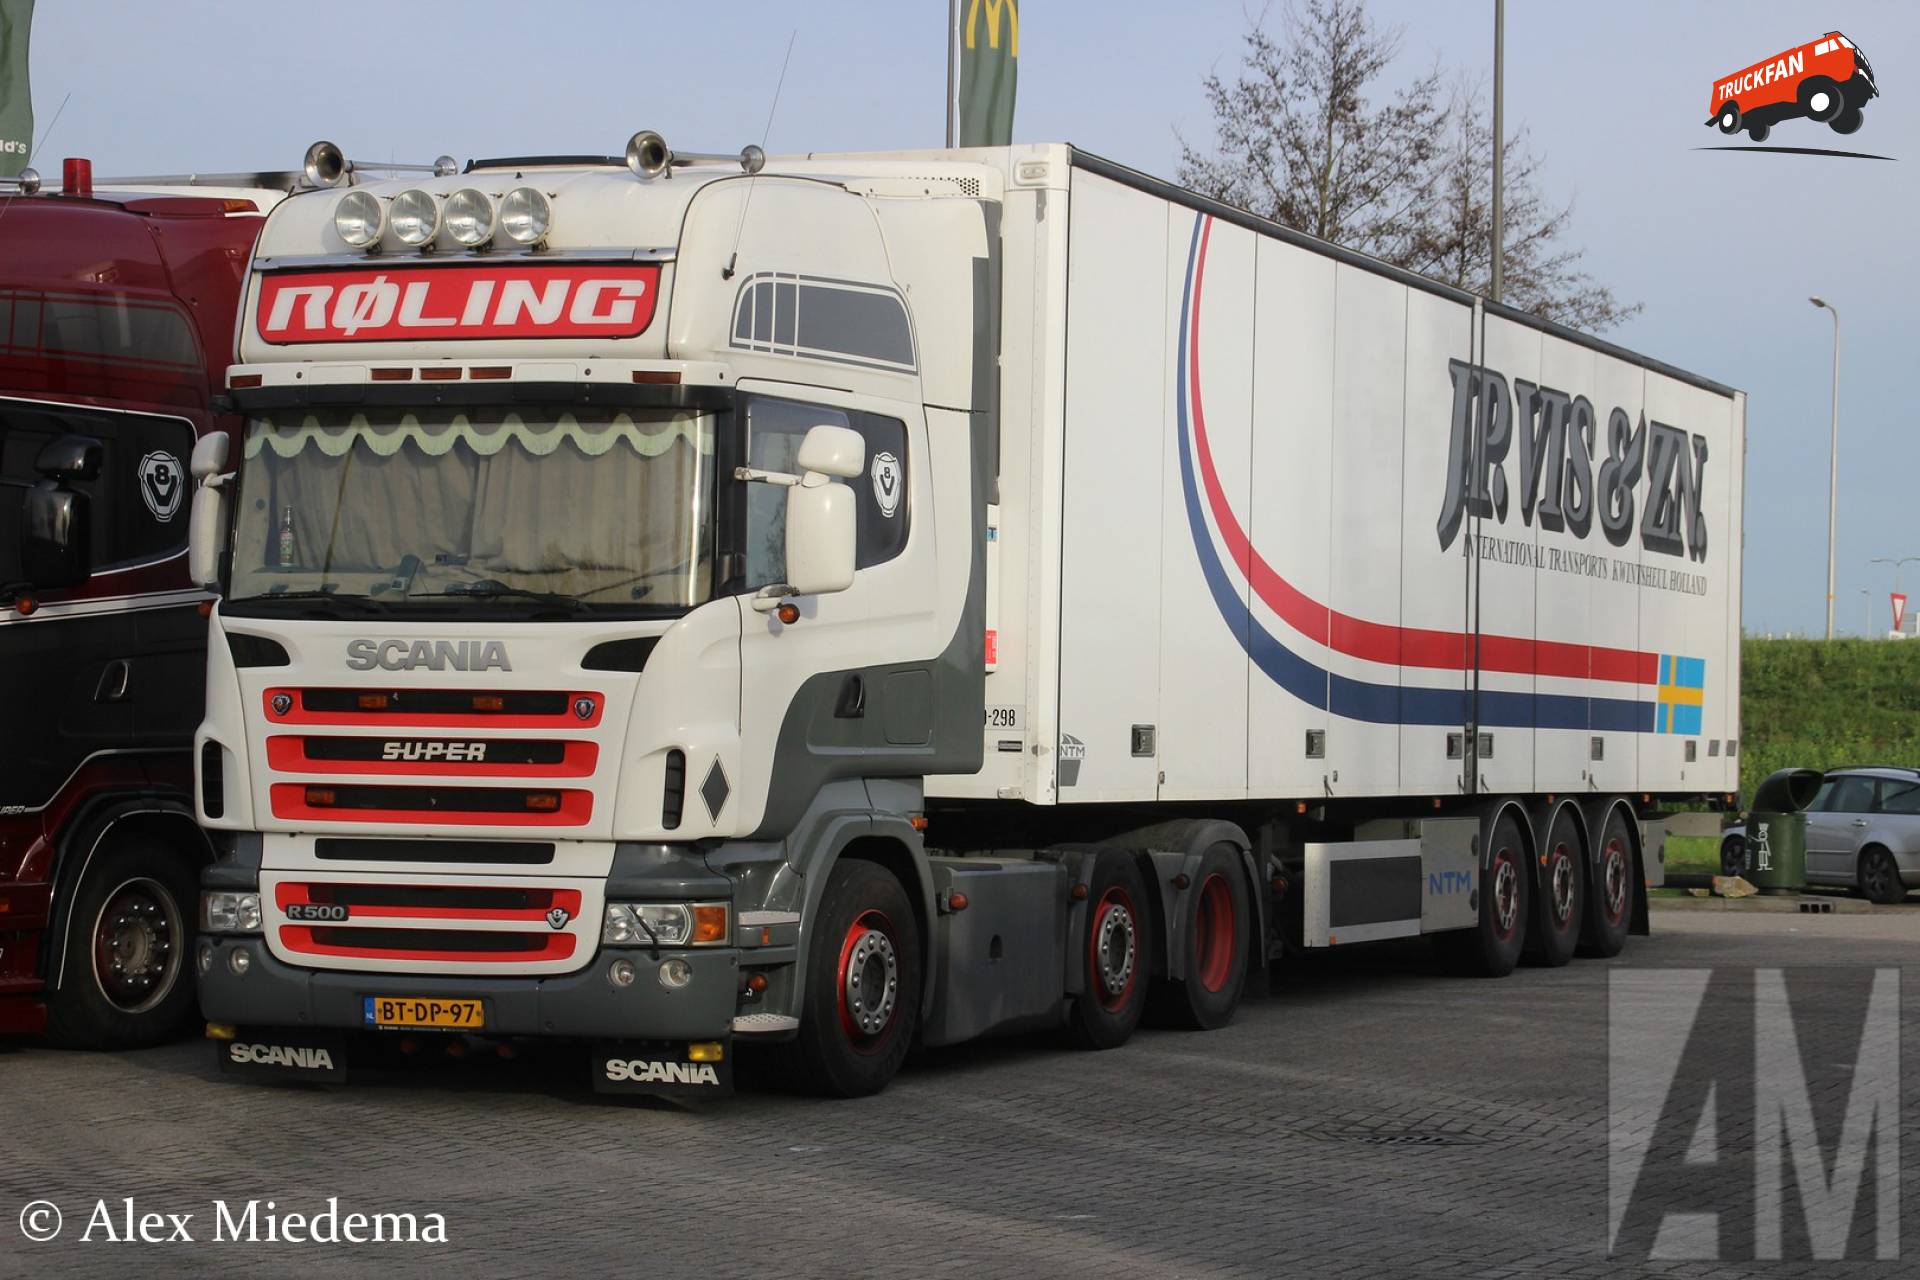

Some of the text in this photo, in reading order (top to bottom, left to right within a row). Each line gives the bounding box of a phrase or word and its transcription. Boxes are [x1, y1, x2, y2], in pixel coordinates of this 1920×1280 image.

[1514, 377, 1596, 540] VIS
[1597, 406, 1646, 547] &
[1463, 533, 1546, 569] INTERNATIONAL
[1548, 546, 1608, 580] TRANSPORTS
[1669, 569, 1708, 597] HOLLAND
[346, 639, 512, 672] SCANIA
[382, 742, 487, 762] SUPER
[1060, 744, 1086, 757] NTM
[1429, 870, 1472, 896] NTM
[383, 1001, 475, 1023] BT-DP-97
[229, 1042, 334, 1070] SCANIA
[606, 1058, 719, 1086] SCANIA
